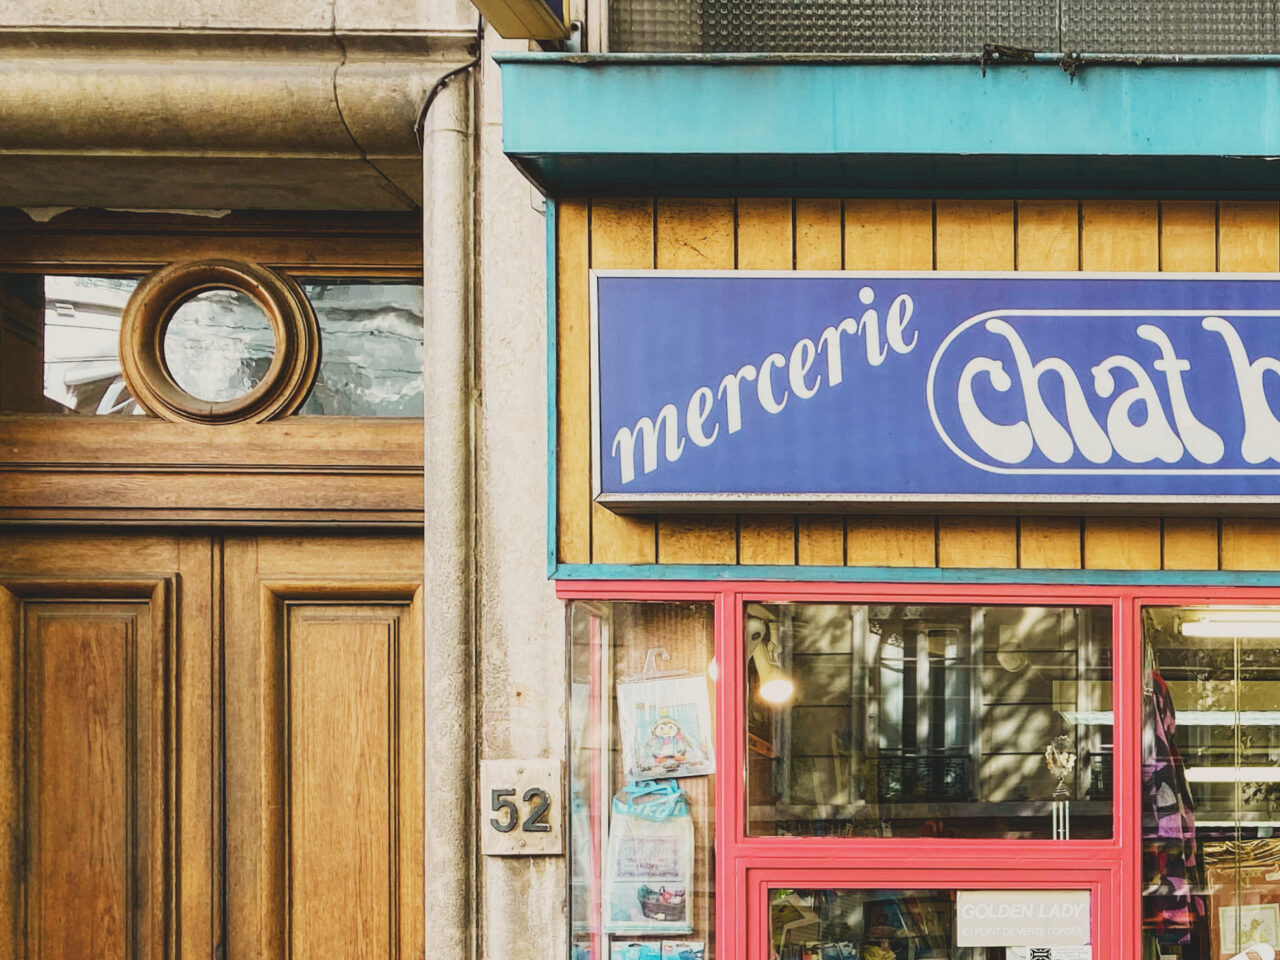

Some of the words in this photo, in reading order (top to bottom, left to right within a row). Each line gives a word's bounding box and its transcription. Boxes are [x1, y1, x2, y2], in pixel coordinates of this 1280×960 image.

[611, 286, 918, 485] mercerie
[957, 317, 1225, 466] chat
[490, 787, 552, 833] 52
[961, 903, 1034, 920] GOLDEN
[1037, 903, 1085, 919] LADY
[974, 927, 1001, 937] POINT
[1003, 927, 1015, 936] DE
